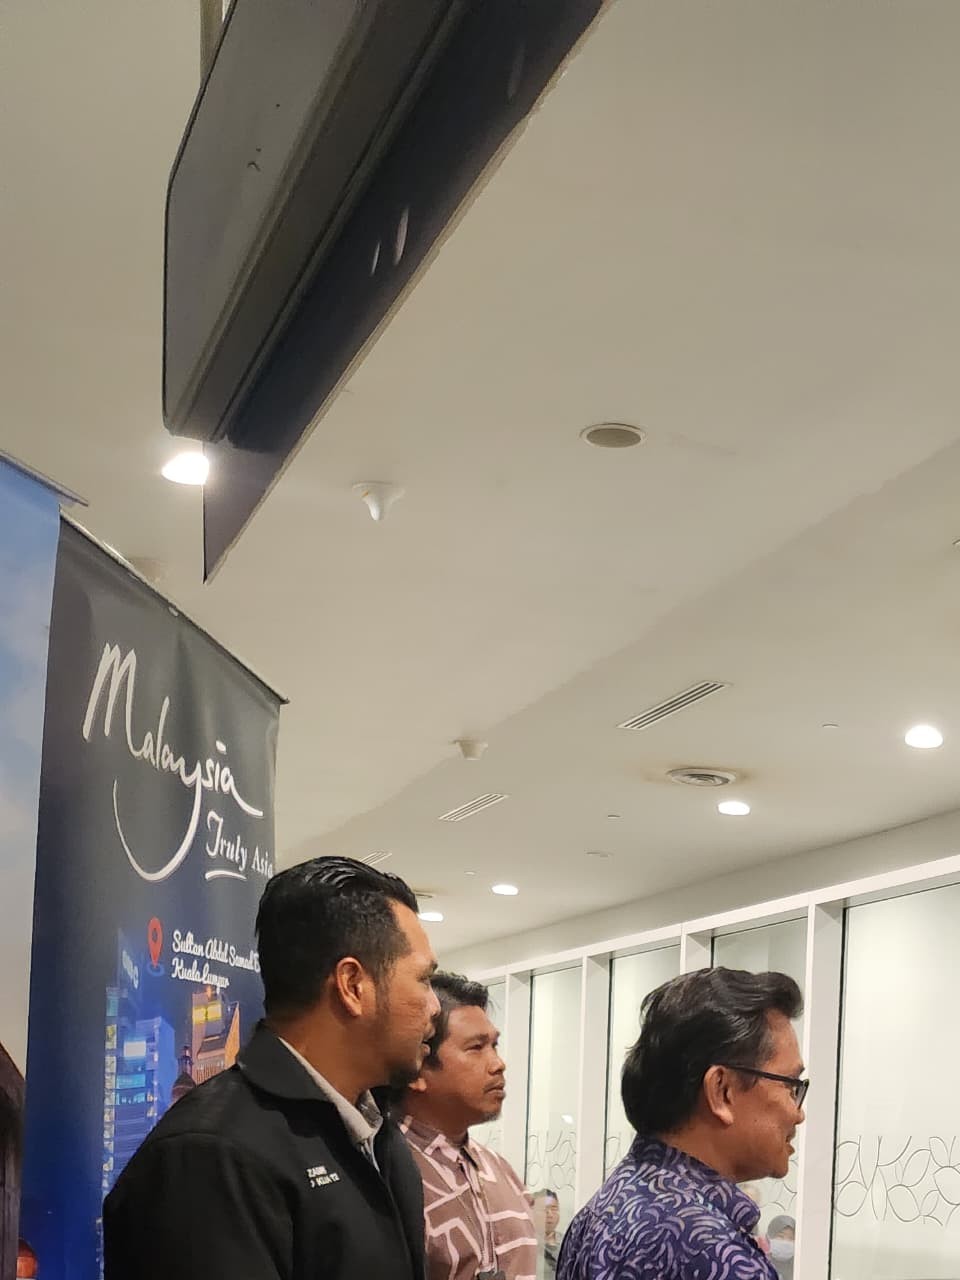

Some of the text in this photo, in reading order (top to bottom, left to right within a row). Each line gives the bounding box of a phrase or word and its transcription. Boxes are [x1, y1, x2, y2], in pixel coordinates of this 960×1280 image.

[83, 642, 263, 881] Malaysia
[206, 810, 274, 879] Truly Asia
[171, 957, 201, 983] Kuala
[172, 929, 204, 957] Sultan
[205, 938, 228, 964] Abdul
[229, 945, 254, 971] Samad
